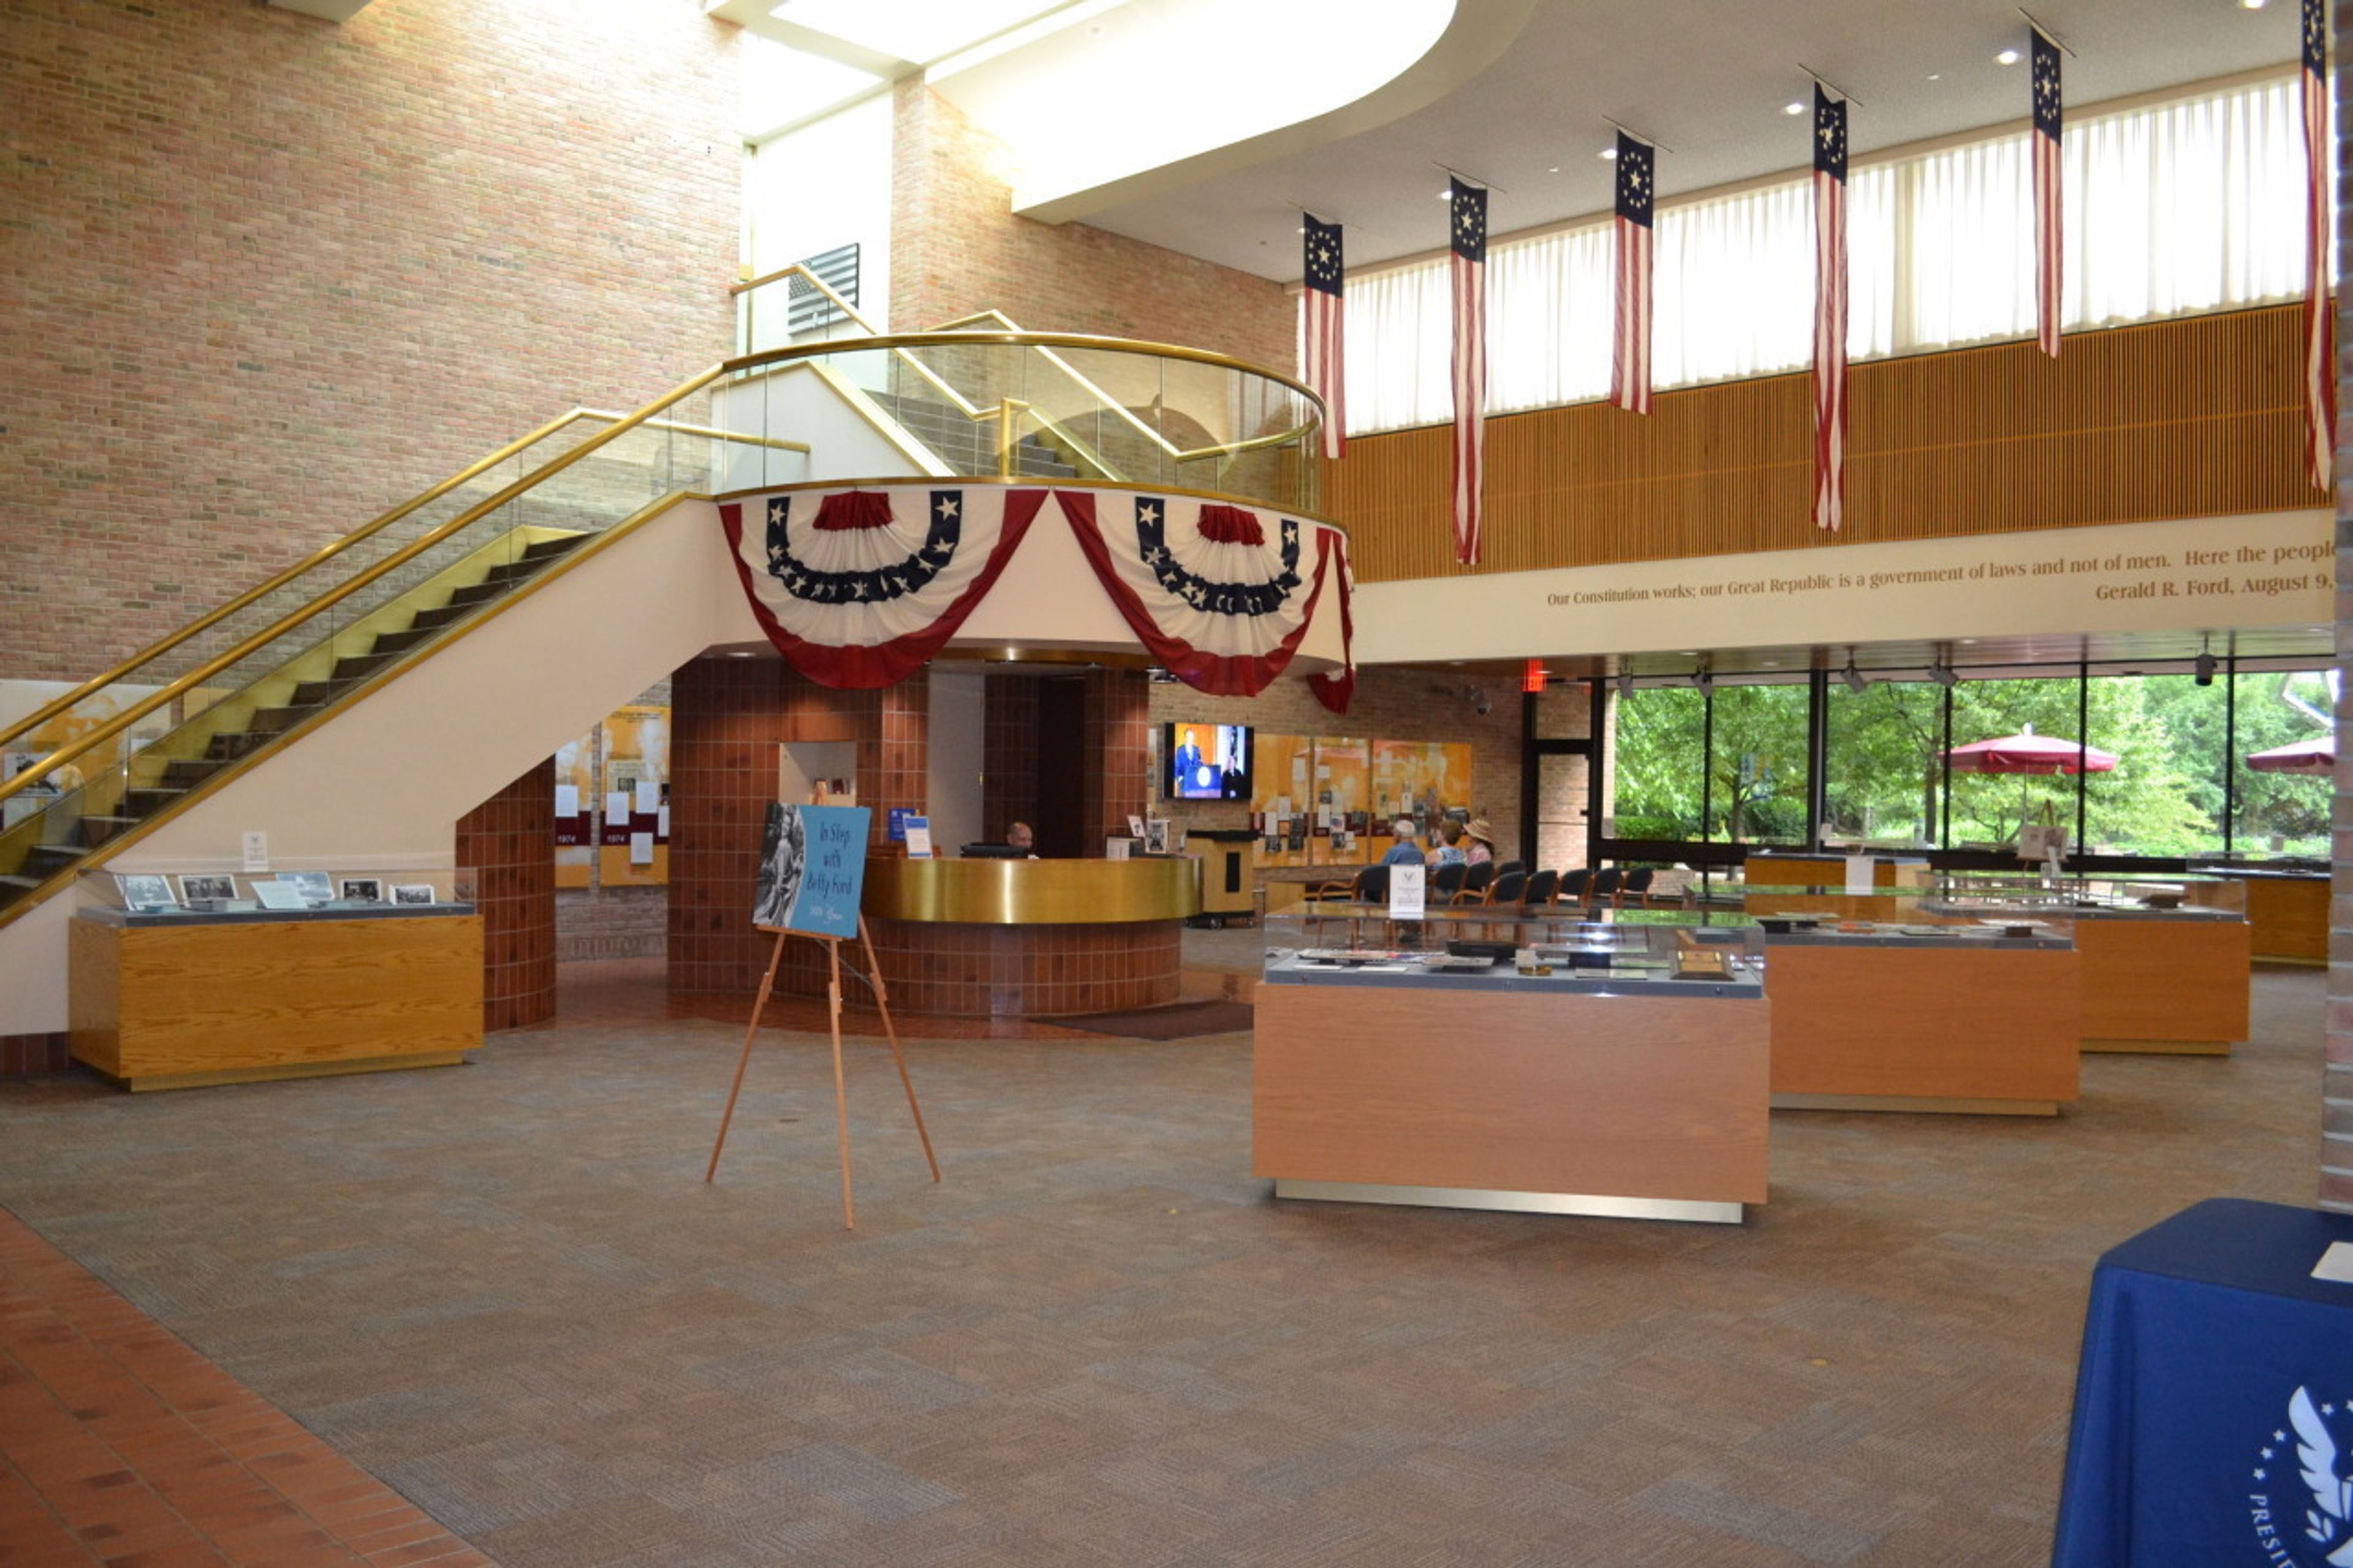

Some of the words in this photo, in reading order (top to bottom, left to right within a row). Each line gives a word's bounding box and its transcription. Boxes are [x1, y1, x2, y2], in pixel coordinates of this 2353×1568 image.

[1548, 593, 1569, 605] Our
[1574, 586, 1649, 604] Constitution
[1653, 583, 1697, 599] works;
[1700, 584, 1723, 596] our
[1727, 578, 1765, 595] Great
[1770, 574, 1835, 594] Republic
[1839, 572, 1851, 588] is
[1857, 575, 1865, 588] a
[1869, 566, 1964, 589] government
[1968, 562, 1985, 580] of
[1989, 562, 2027, 578] laws
[2032, 558, 2064, 575] and
[2069, 558, 2098, 574] not
[2104, 553, 2123, 570] of
[2126, 553, 2172, 570] men.
[2184, 550, 2230, 566] Here
[2236, 546, 2267, 562] the
[2096, 580, 2155, 600] Gerald
[2161, 581, 2180, 597] R.
[2187, 577, 2235, 596] Ford,
[2241, 574, 2309, 596] August
[830, 823, 851, 850] Step
[823, 849, 841, 868] with
[806, 871, 830, 899] Betty
[832, 874, 852, 896] Ford
